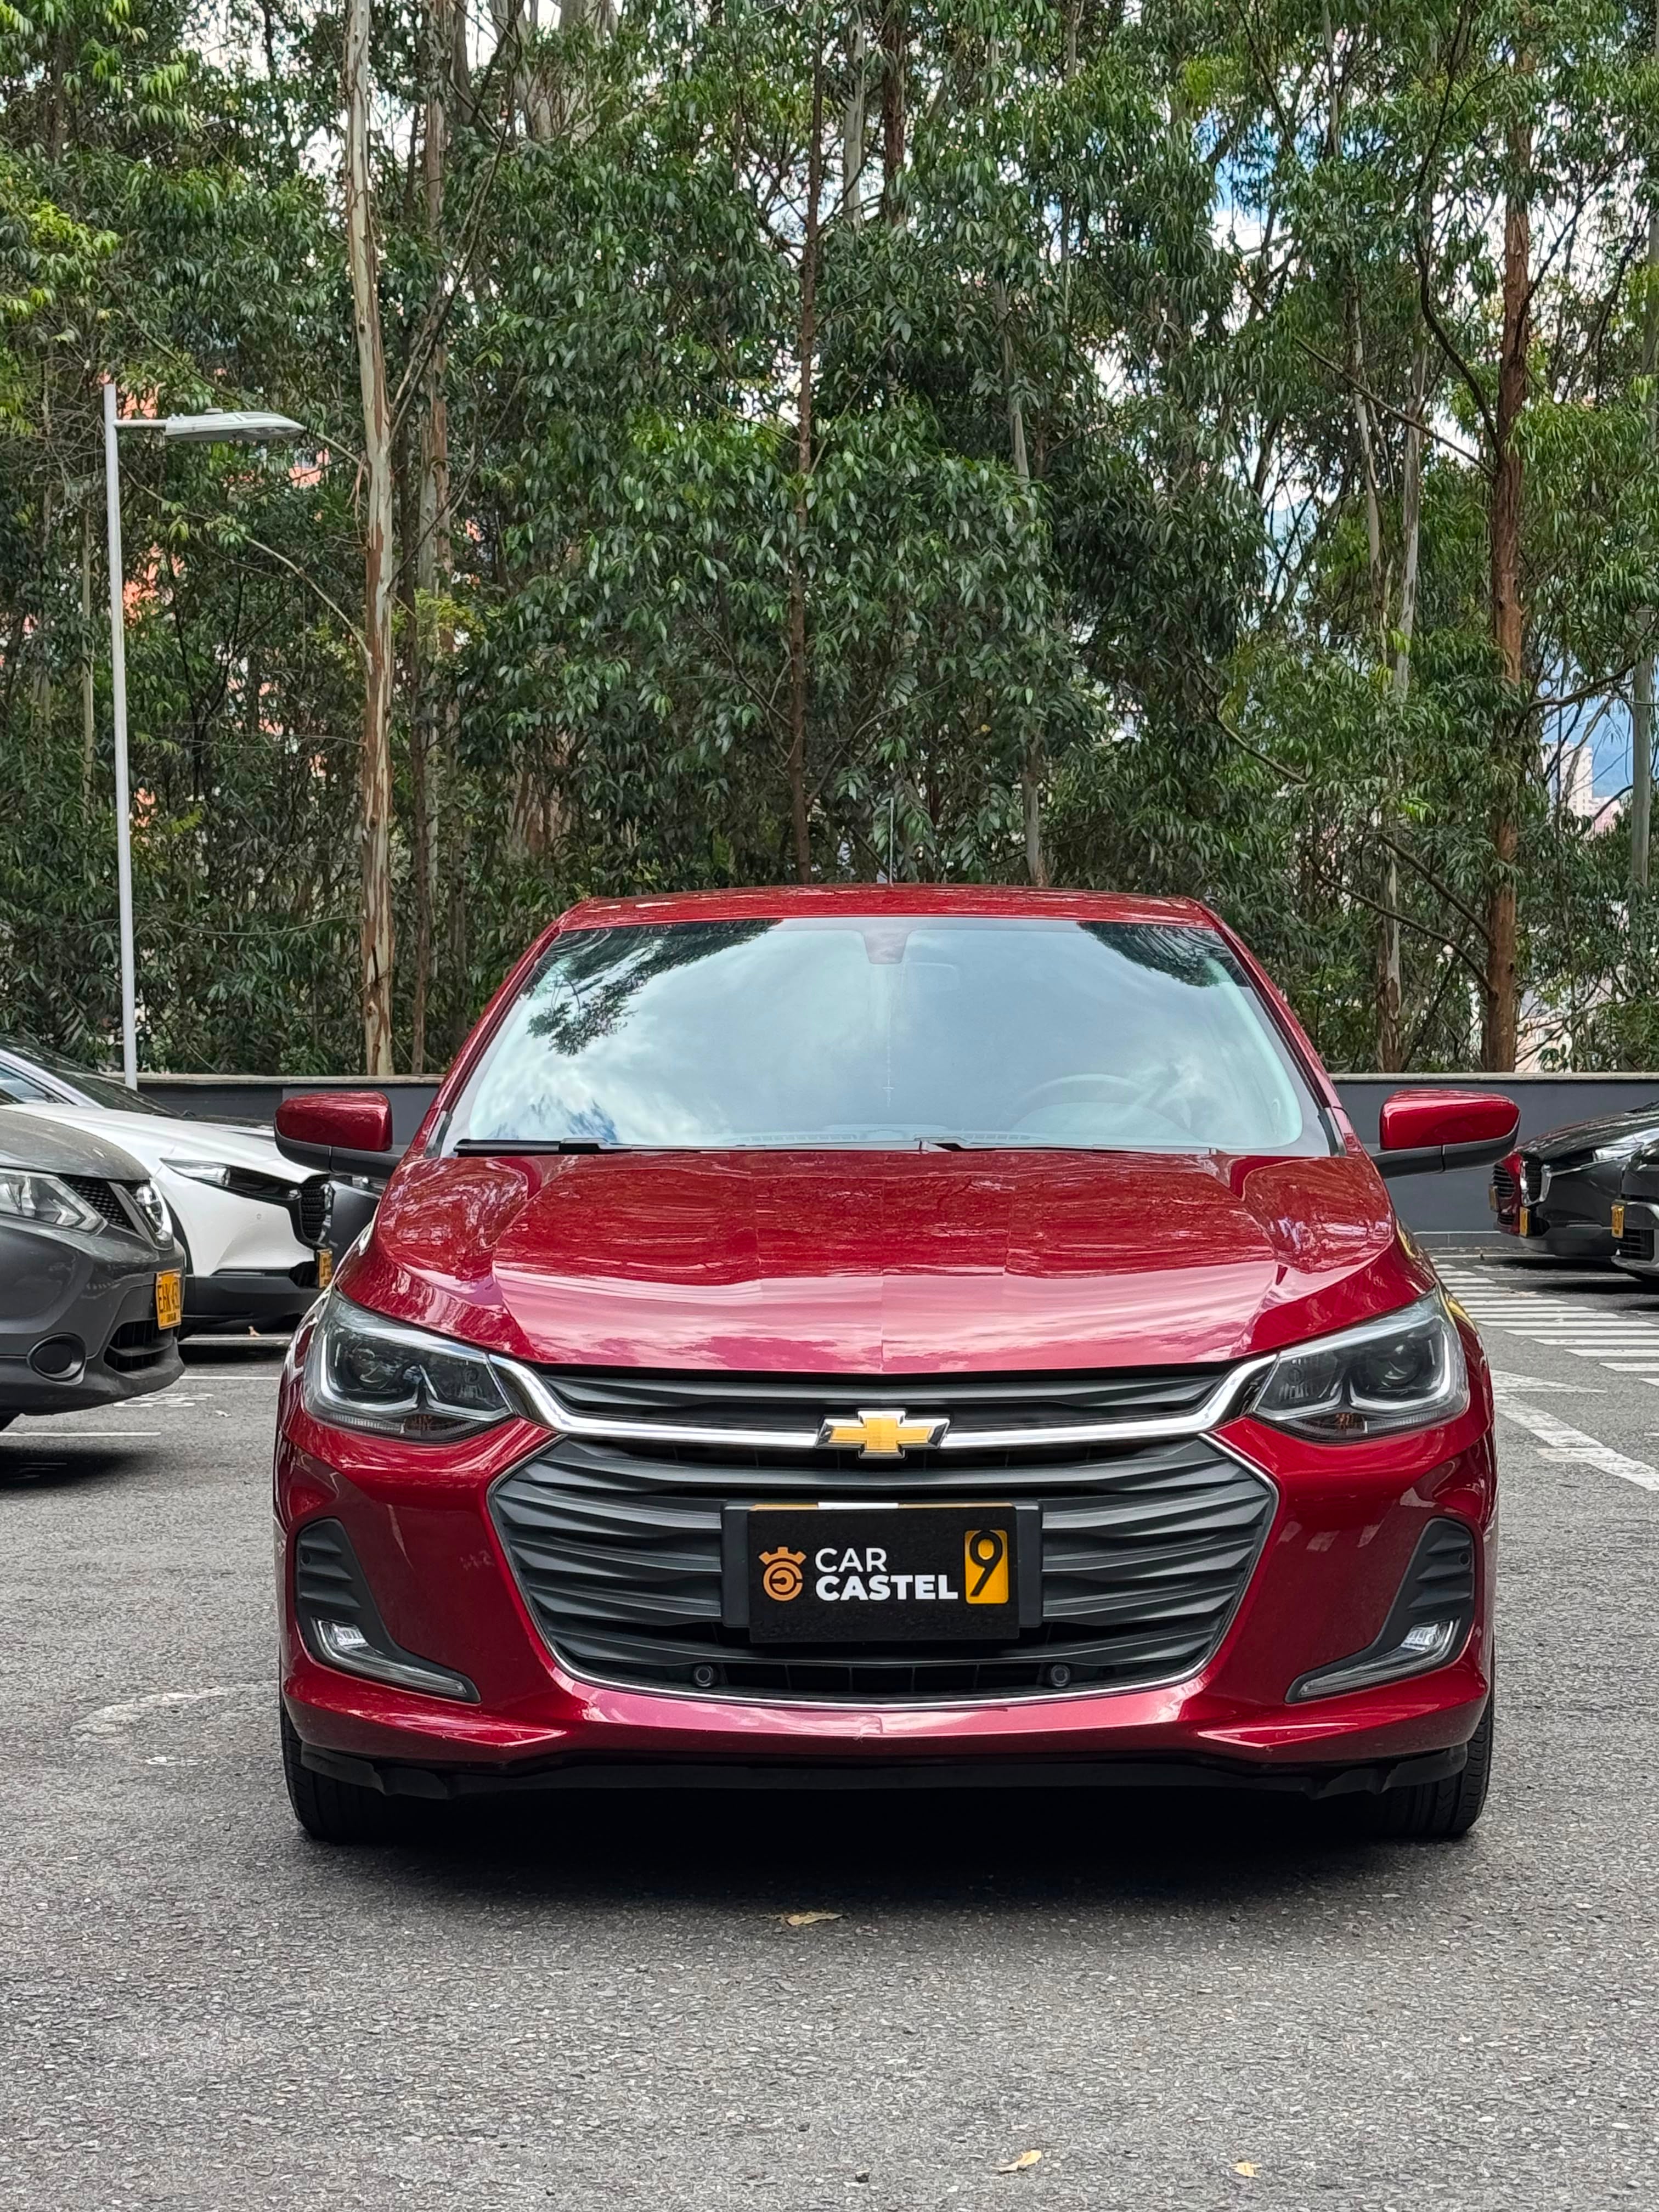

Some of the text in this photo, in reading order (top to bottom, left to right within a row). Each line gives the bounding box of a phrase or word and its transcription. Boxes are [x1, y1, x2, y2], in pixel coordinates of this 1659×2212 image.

[815, 1548, 887, 1572] CAR
[969, 1530, 1003, 1597] 9
[815, 1575, 958, 1601] CASTEL
